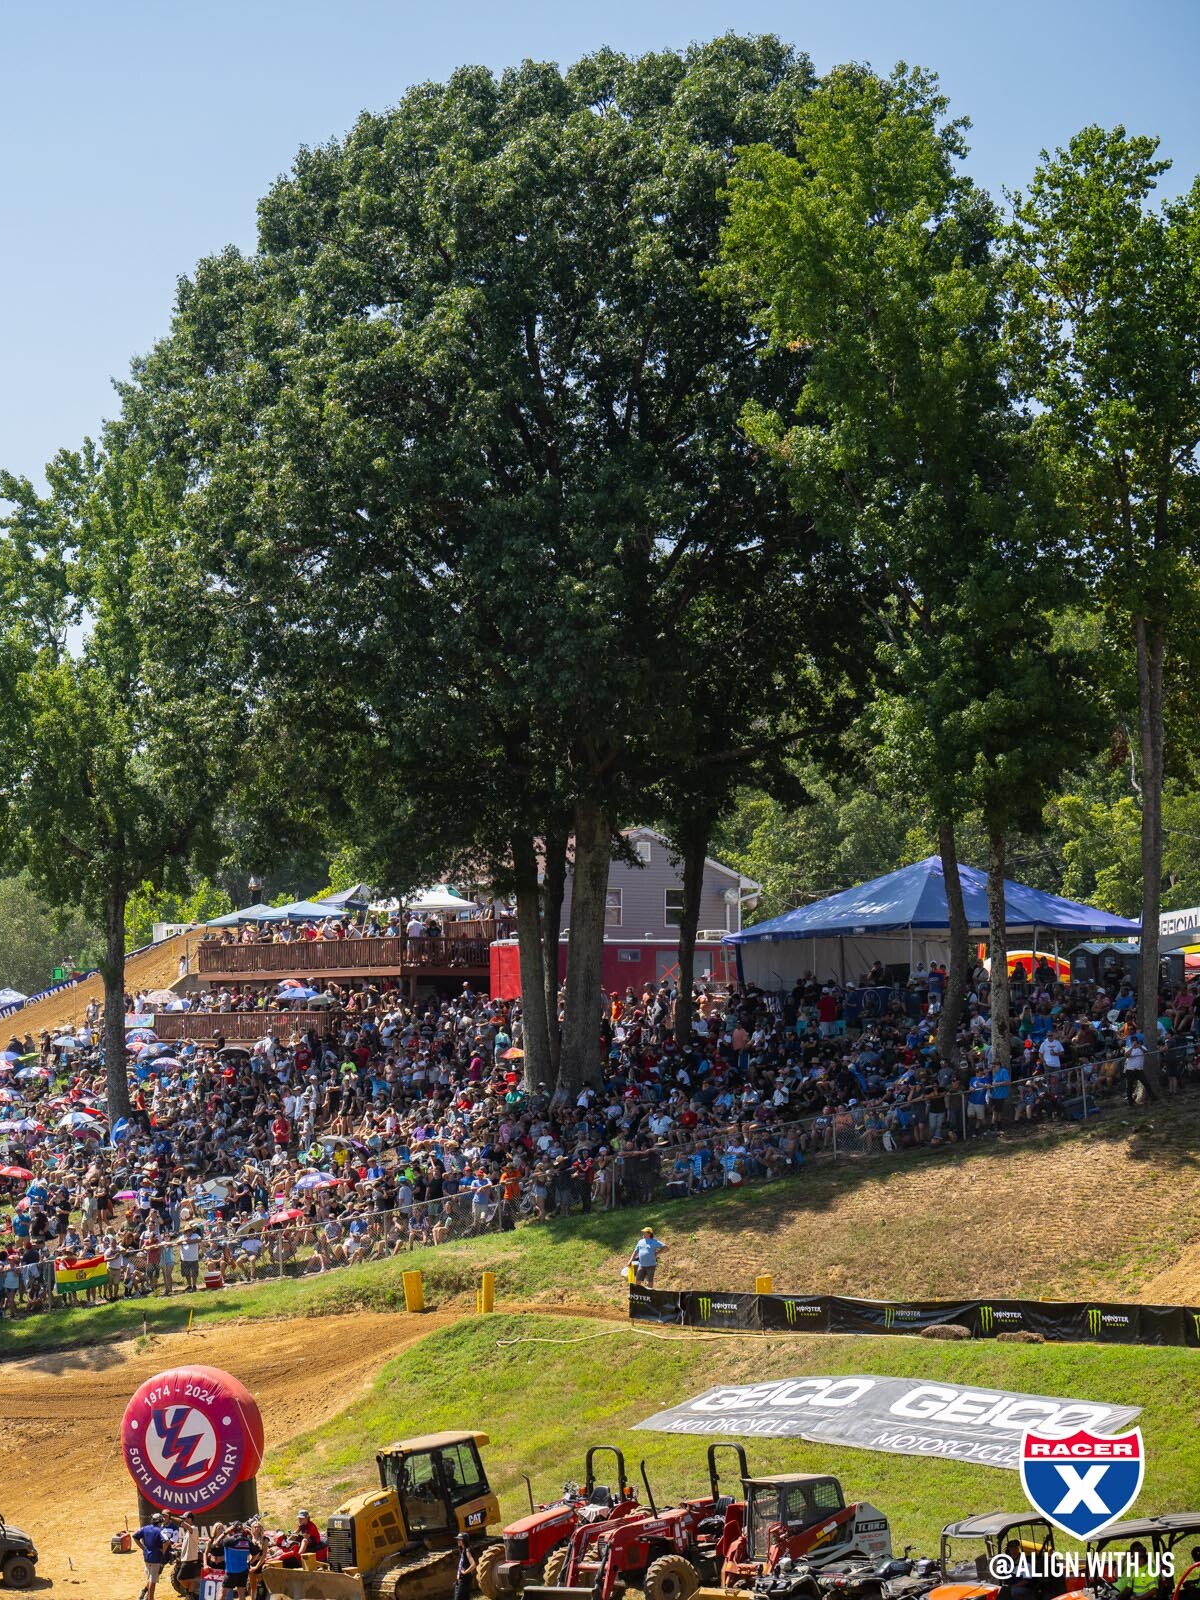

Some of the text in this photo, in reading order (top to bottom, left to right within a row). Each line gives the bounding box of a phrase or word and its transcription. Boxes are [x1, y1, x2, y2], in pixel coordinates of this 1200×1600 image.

[711, 1302, 738, 1310] MONSTER
[796, 1305, 822, 1313] MONSTER
[992, 1311, 1022, 1319] MONSTER
[1101, 1315, 1129, 1323] MONSTER
[144, 1385, 171, 1407] 1974
[184, 1384, 216, 1406] 2024
[690, 1378, 876, 1411] GEICO
[889, 1385, 1112, 1434] GEICO
[665, 1418, 798, 1433] MOTORCYCLE
[129, 1443, 238, 1505] 50TH ANNIVERSARY
[334, 1520, 343, 1528] CAT
[468, 1511, 483, 1526] CAT
